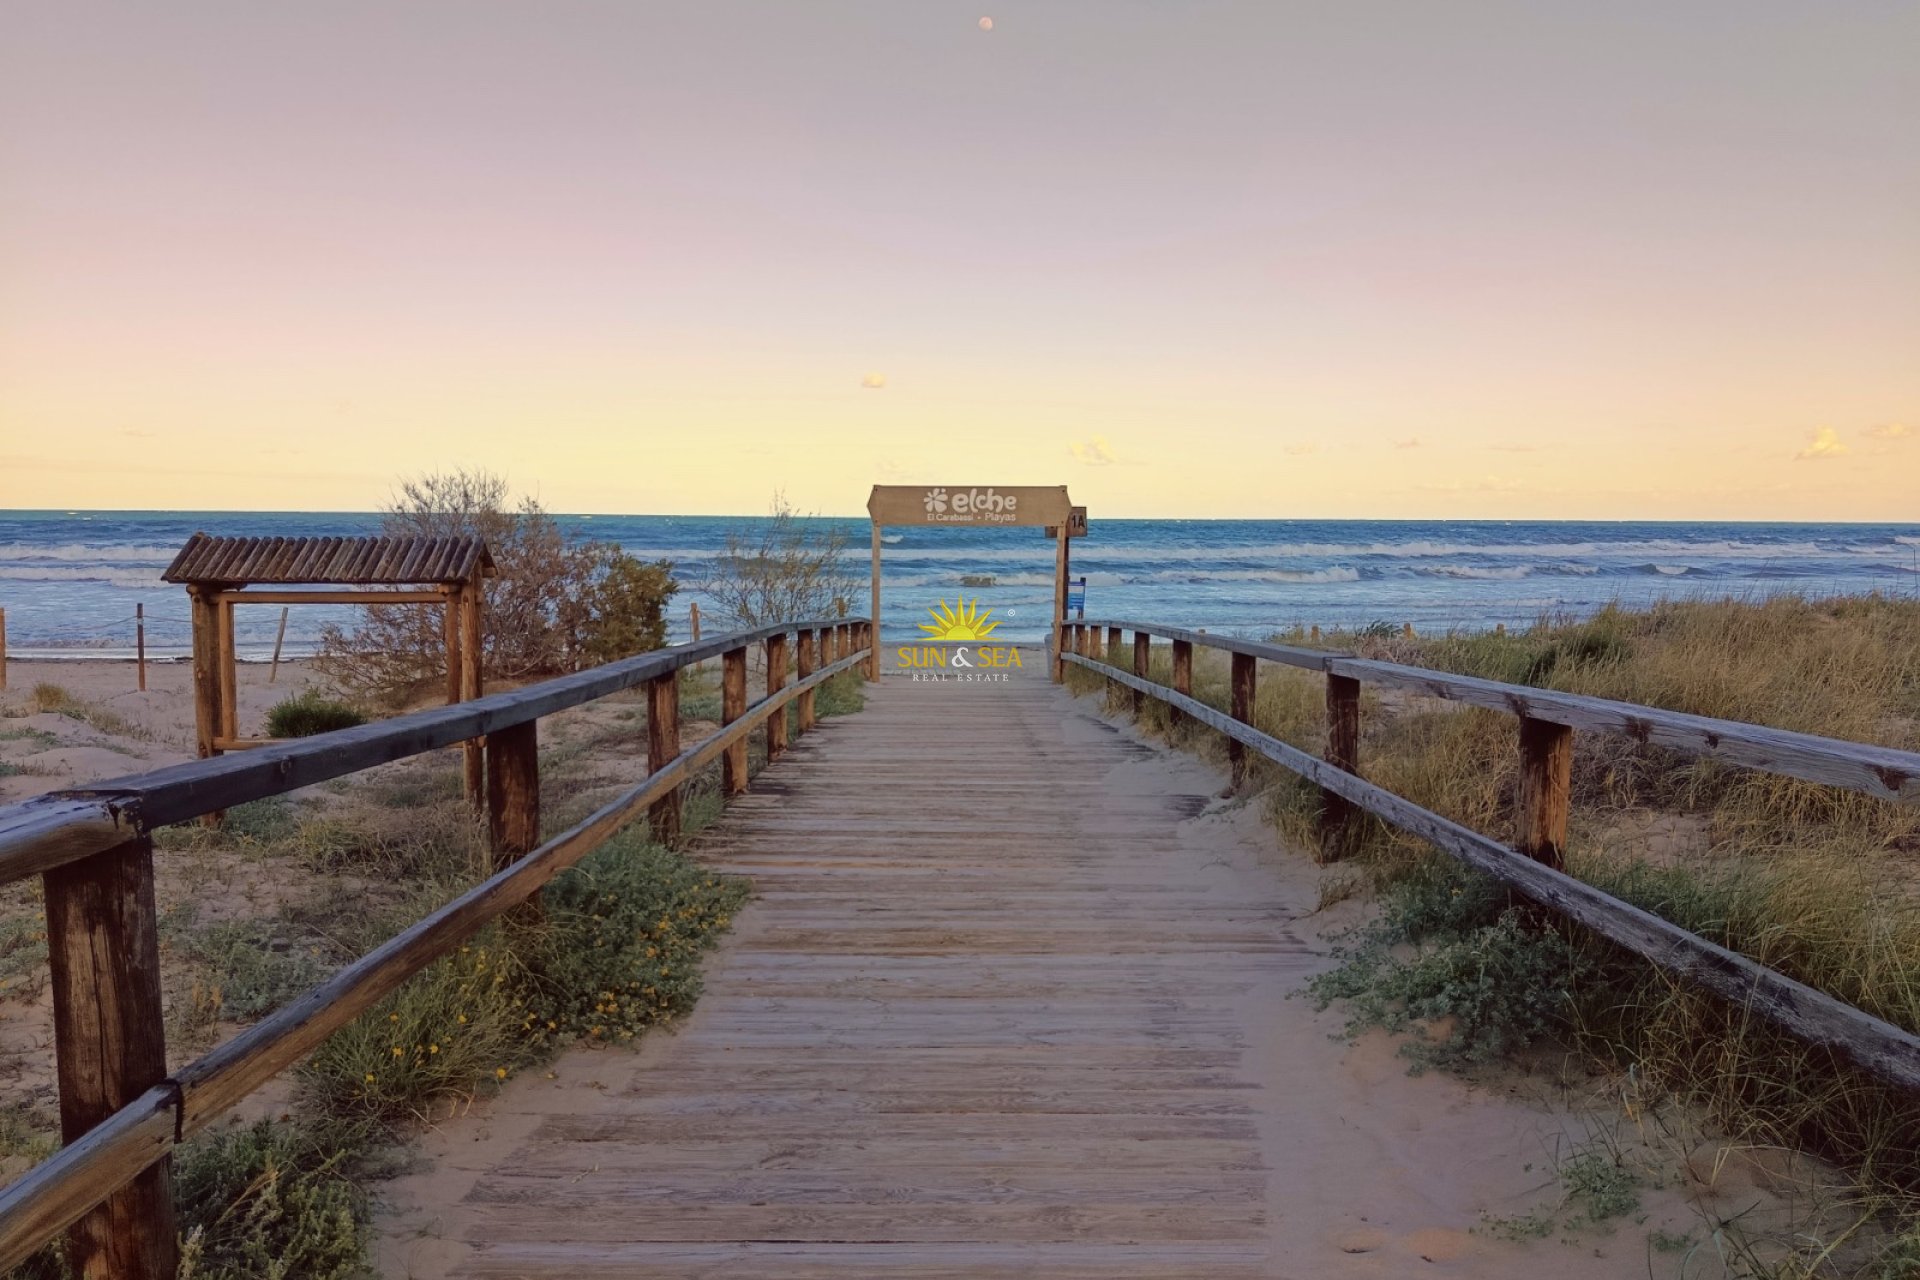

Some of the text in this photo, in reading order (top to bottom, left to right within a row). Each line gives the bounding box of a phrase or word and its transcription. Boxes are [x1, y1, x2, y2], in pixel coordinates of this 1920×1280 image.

[951, 488, 1017, 513] elche
[927, 513, 935, 521] El
[985, 512, 1016, 523] Playas
[1072, 515, 1085, 528] 1A
